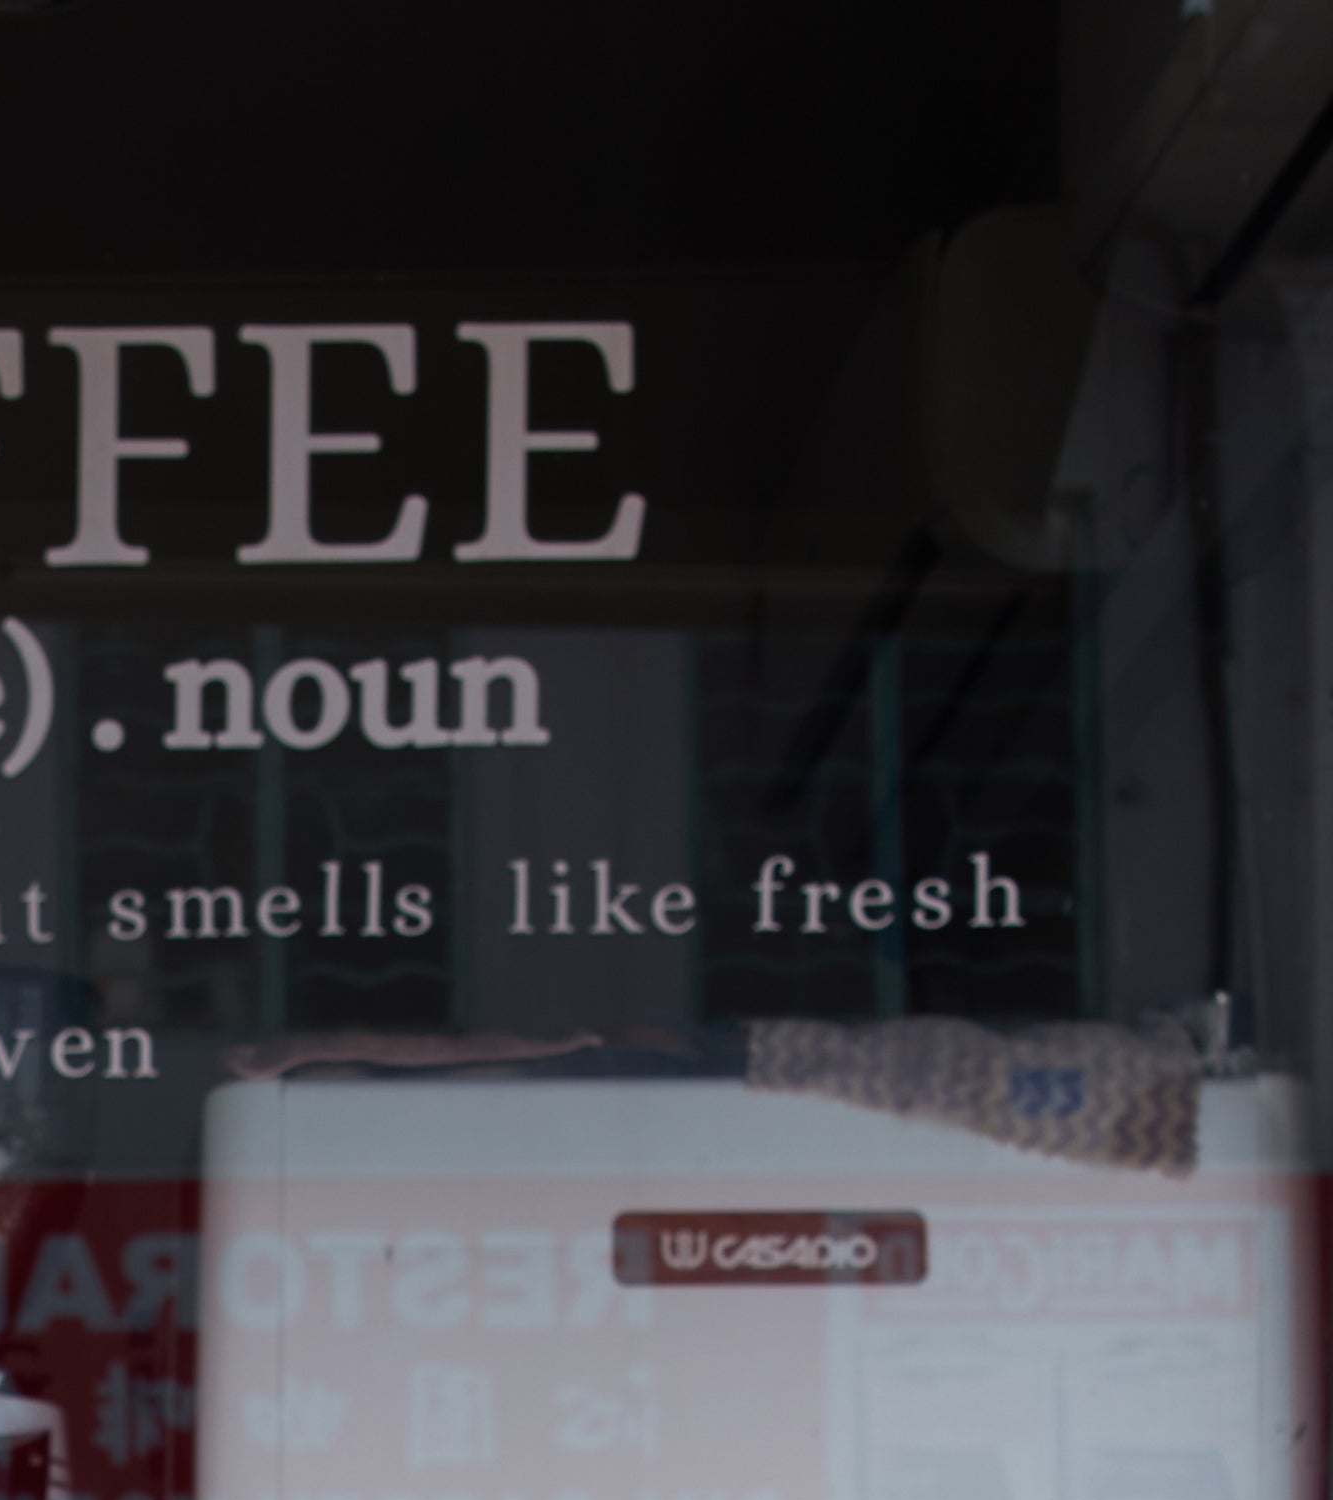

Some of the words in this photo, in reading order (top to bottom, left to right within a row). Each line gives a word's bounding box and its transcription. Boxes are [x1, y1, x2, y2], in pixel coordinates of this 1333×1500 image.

[164, 657, 550, 749] noun
[106, 861, 436, 939] smells
[509, 858, 700, 937] like
[751, 852, 1028, 931] fresh
